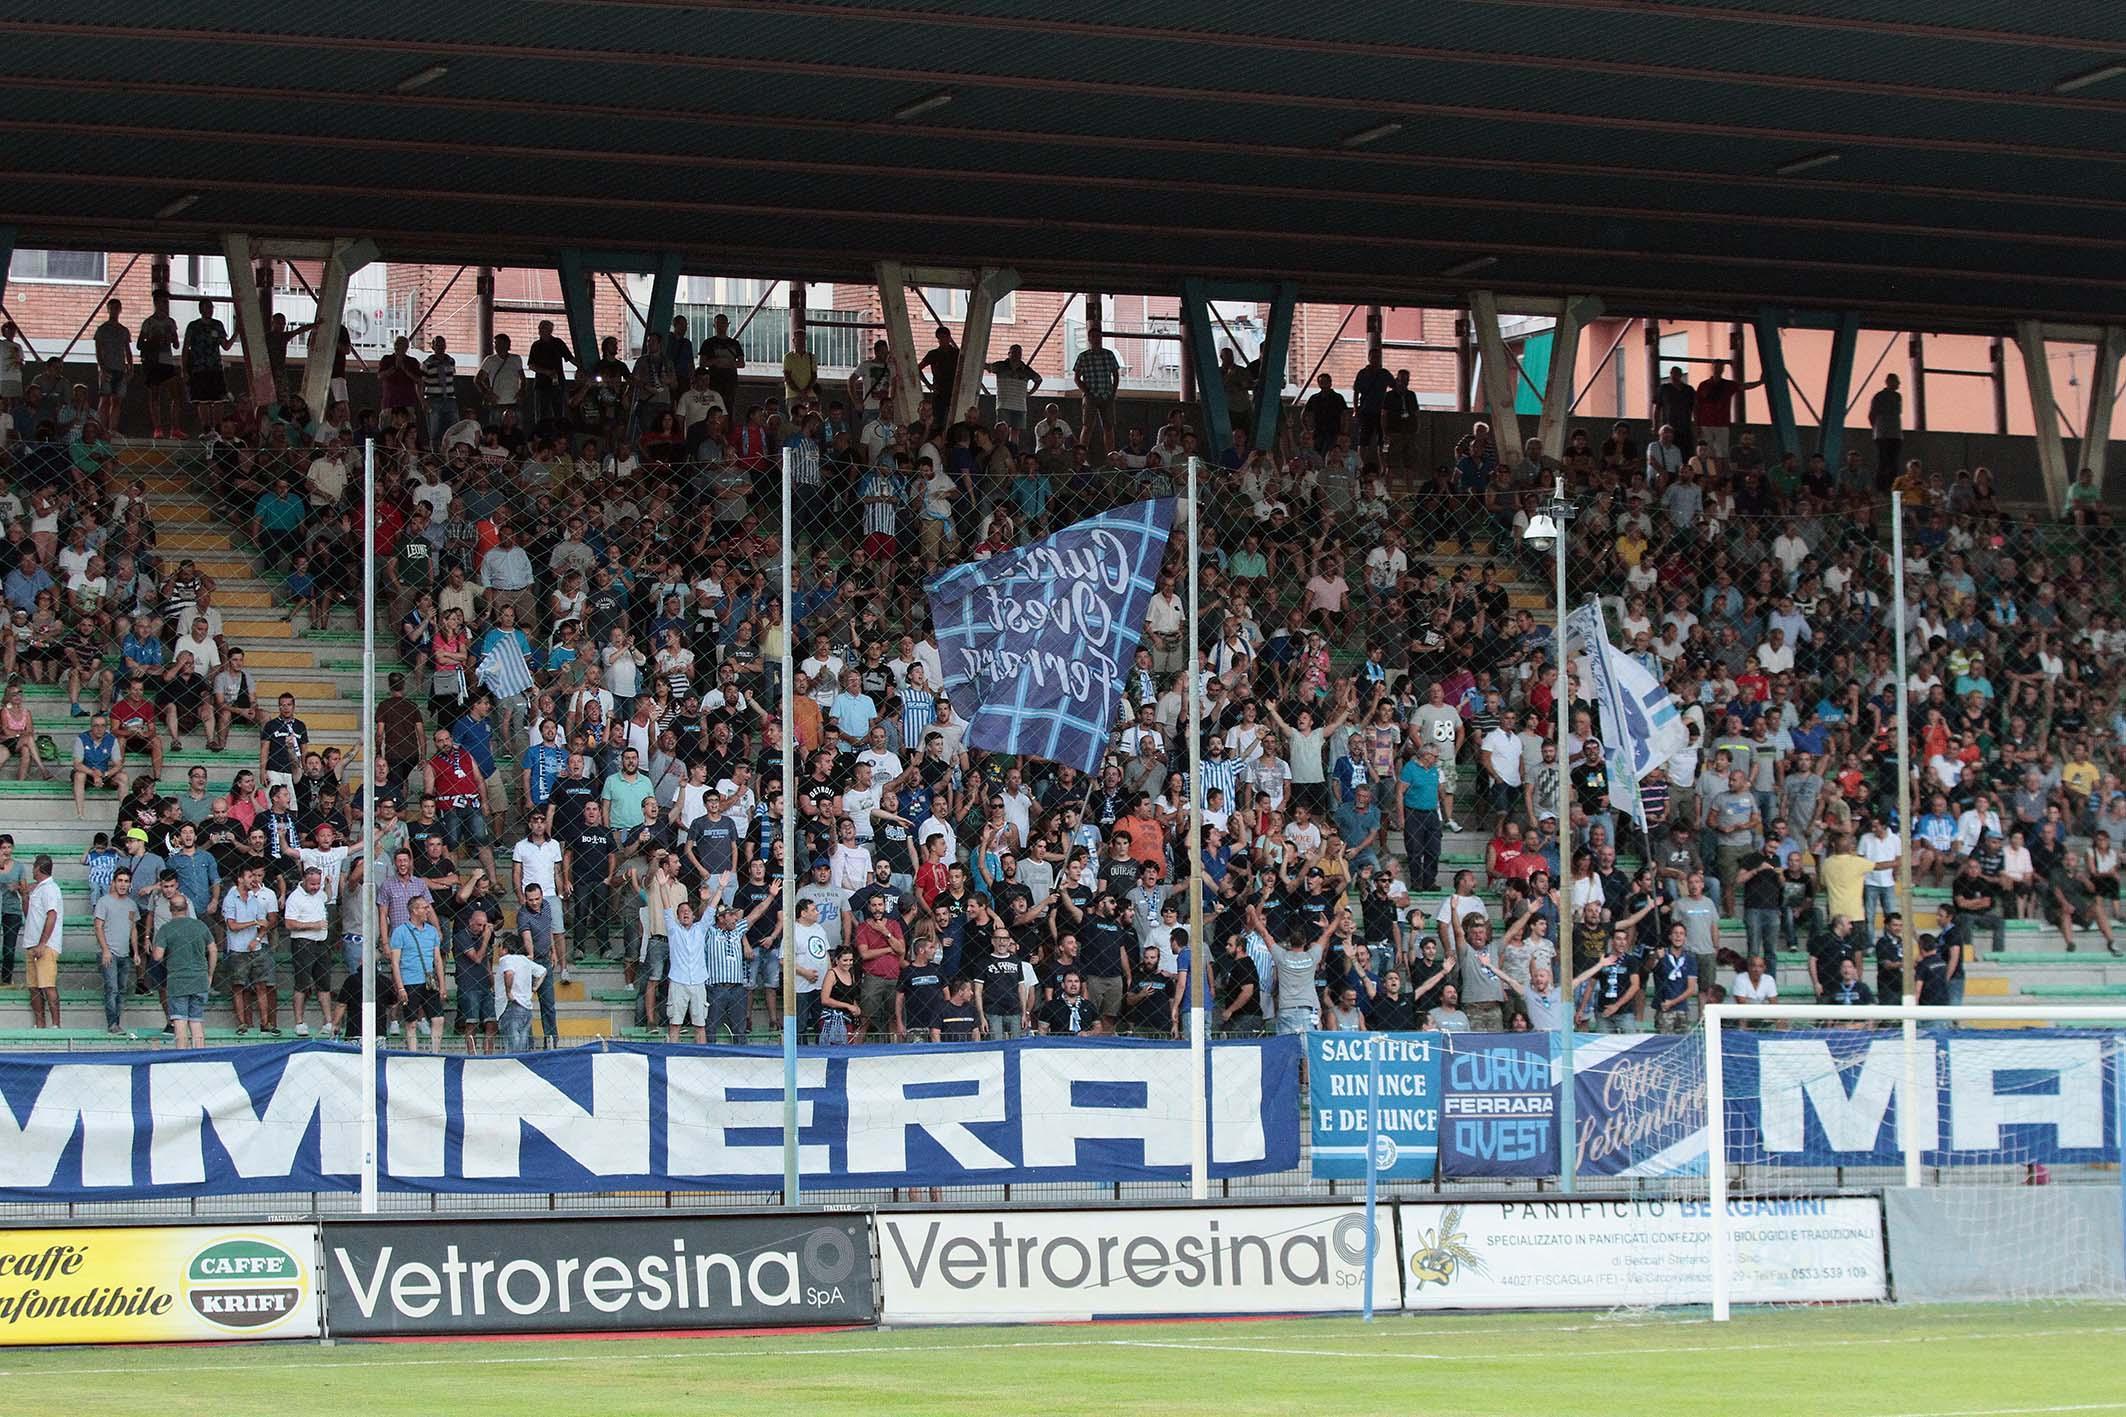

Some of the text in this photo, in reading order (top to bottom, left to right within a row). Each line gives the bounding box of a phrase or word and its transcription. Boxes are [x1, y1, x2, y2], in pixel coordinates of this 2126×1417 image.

[1451, 1047, 1550, 1090] CURVA
[1444, 1097, 1554, 1113] FERRARA
[1758, 1037, 2121, 1152] MA
[0, 1046, 1265, 1187] MMINERAI
[1319, 1109, 1333, 1131] E
[1455, 1119, 1551, 1161] OVEST
[1501, 1202, 1665, 1219] PANIFICIO
[1487, 1234, 1572, 1246] SPECIALIZZATO
[1575, 1234, 1586, 1245] IN
[1589, 1233, 1648, 1245] PANIFICATI
[1734, 1231, 1788, 1242] BIOLOGICI
[1791, 1231, 1798, 1241] E
[1800, 1229, 1874, 1241] TRADIZIONALI
[885, 1218, 1329, 1290] Vetroresina
[334, 1238, 801, 1318] Vetroresina
[1535, 1274, 1593, 1286] FISCAGLIA
[1791, 1268, 1819, 1280] 0533
[201, 1294, 287, 1313] KRIFI
[807, 1286, 845, 1308] SpA
